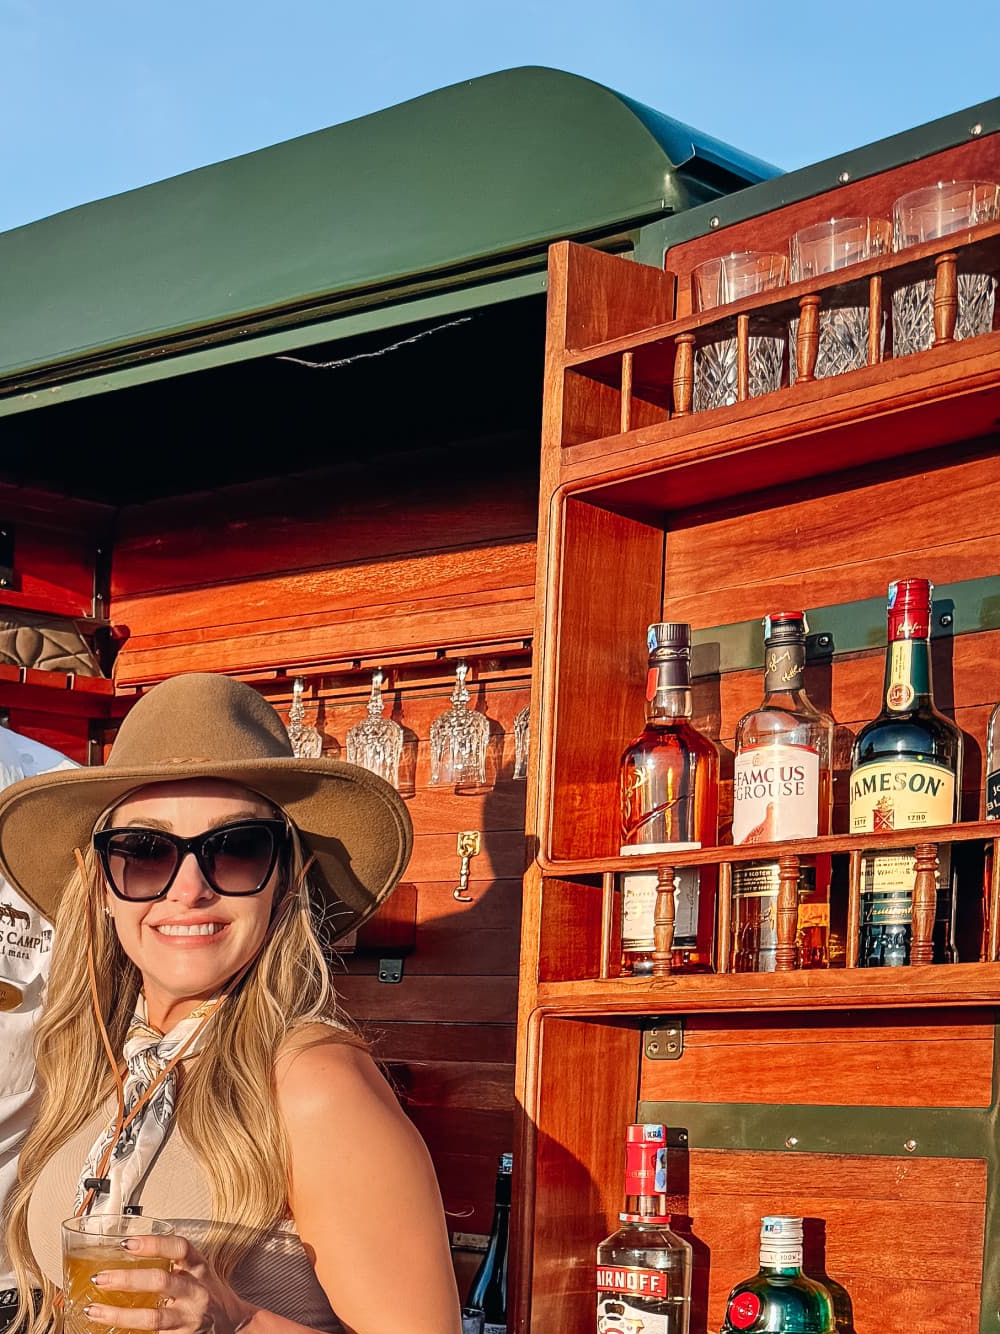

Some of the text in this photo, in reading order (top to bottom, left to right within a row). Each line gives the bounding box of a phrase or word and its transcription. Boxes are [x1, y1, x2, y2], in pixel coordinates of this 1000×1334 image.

[737, 765, 805, 786] FAMOUS
[736, 782, 805, 801] GROUSE
[850, 772, 942, 805] JAMESON
[6, 931, 41, 949] CAMP
